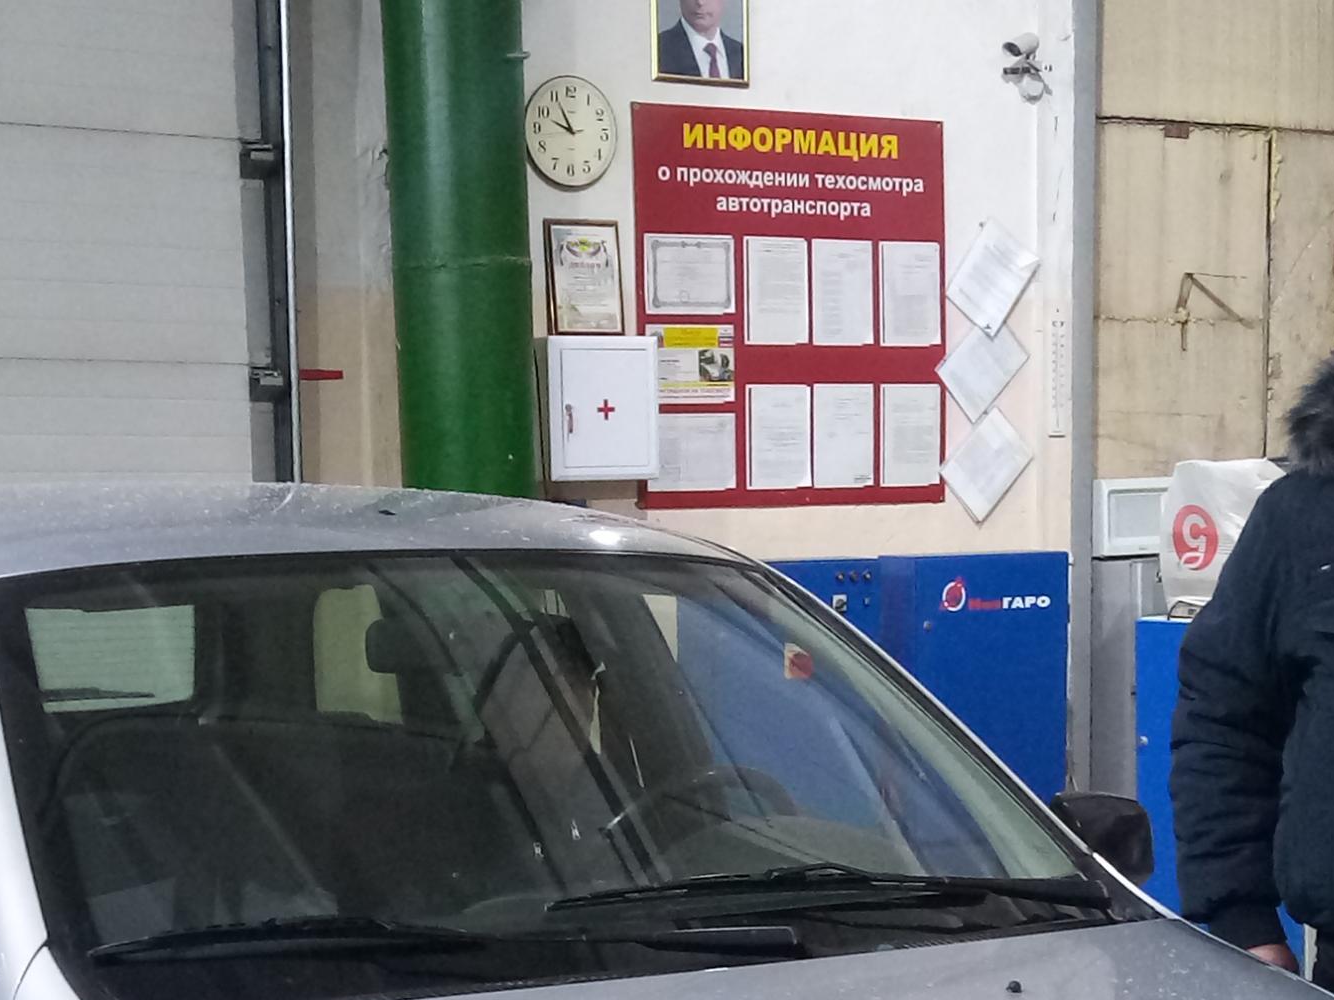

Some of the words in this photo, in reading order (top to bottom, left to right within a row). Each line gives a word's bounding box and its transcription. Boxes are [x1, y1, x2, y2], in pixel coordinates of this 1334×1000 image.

[682, 122, 899, 162] ИНФОРМАЦИЯ
[658, 165, 671, 182] о
[676, 166, 810, 189] прохождении
[814, 173, 925, 198] техосмотра
[716, 196, 872, 221] автотранспорта
